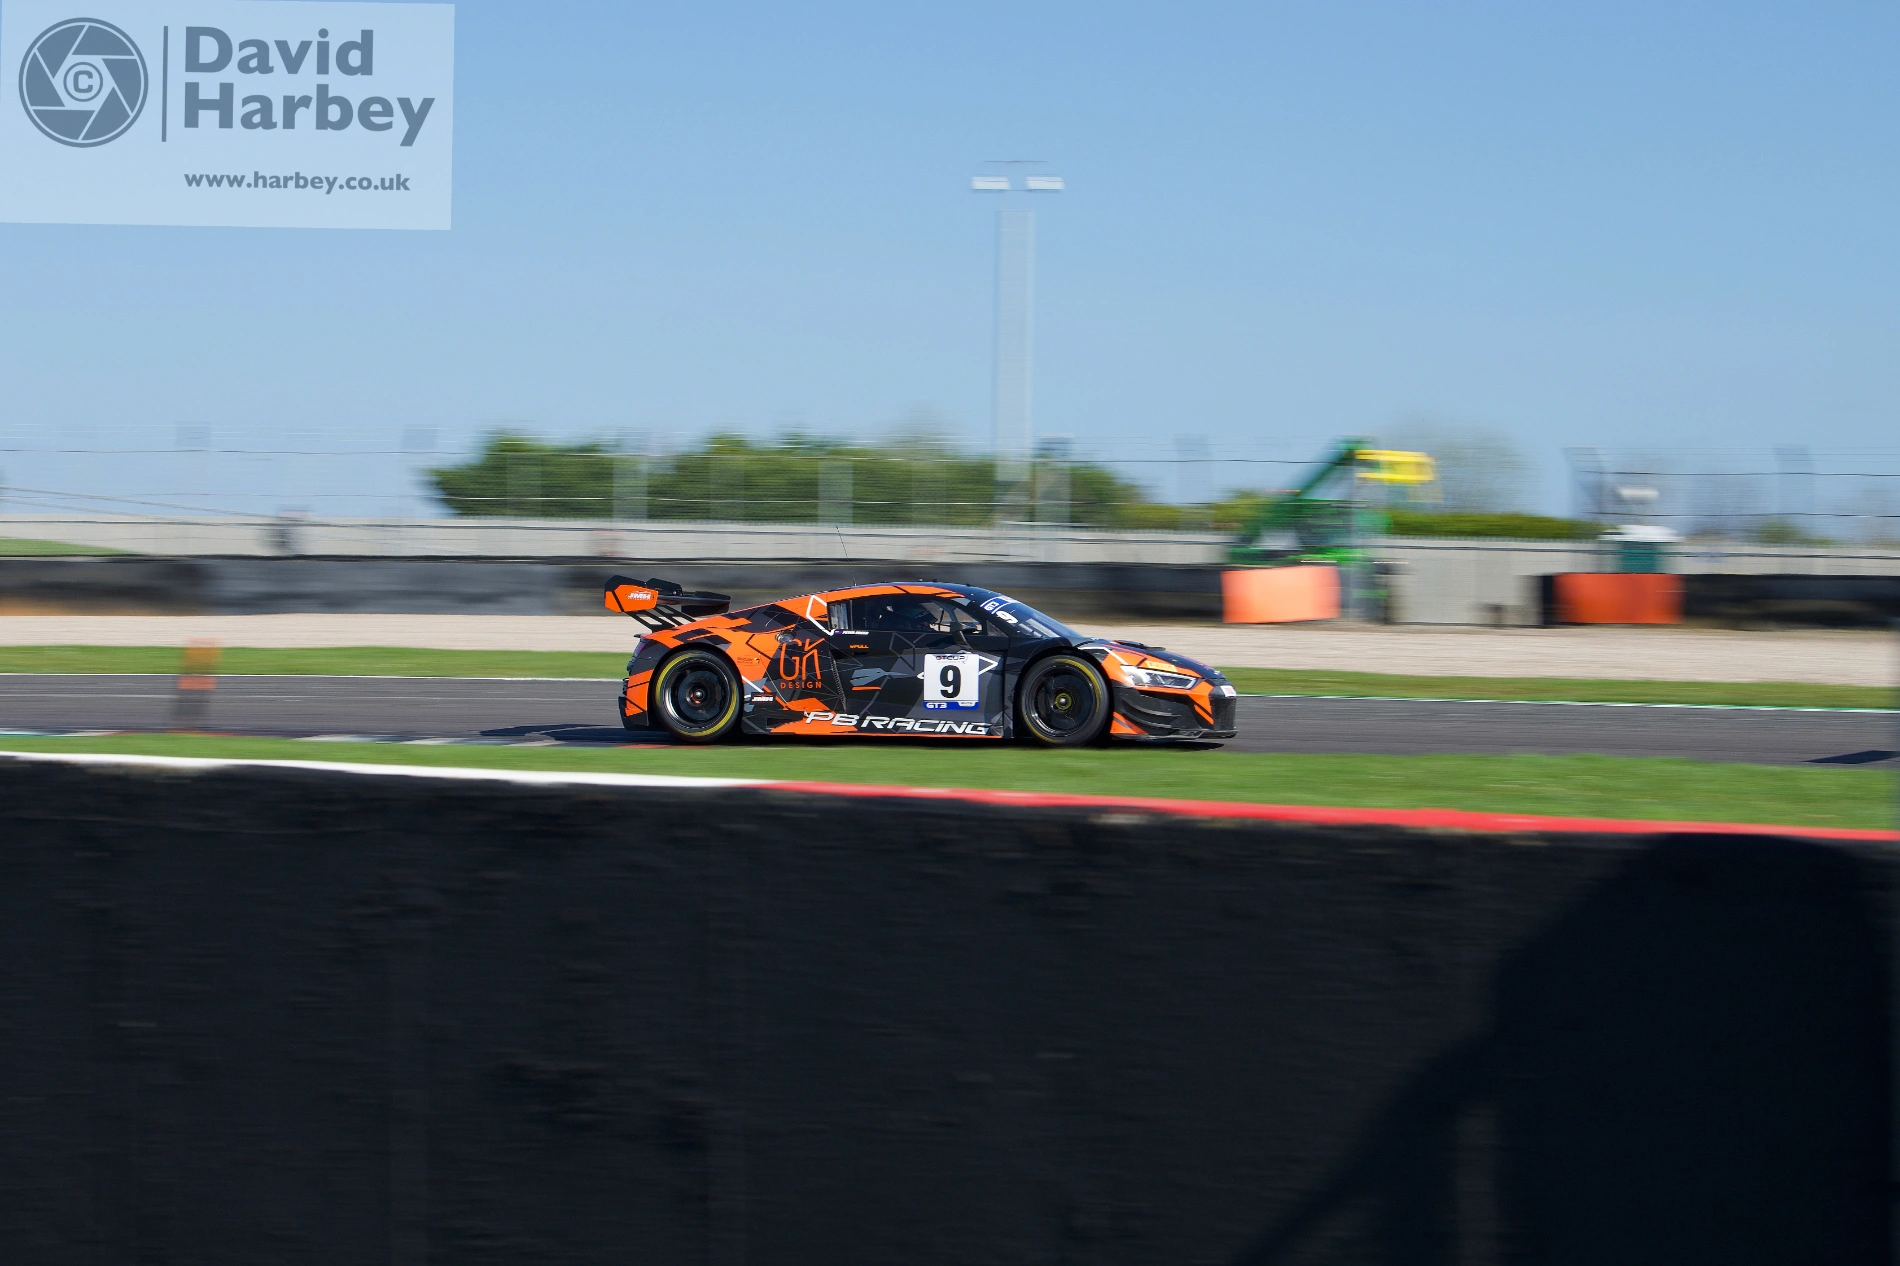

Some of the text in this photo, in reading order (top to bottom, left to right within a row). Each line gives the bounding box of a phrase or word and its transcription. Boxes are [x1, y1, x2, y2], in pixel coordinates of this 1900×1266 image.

[940, 665, 961, 699] 9
[804, 711, 992, 735] PB RACING
